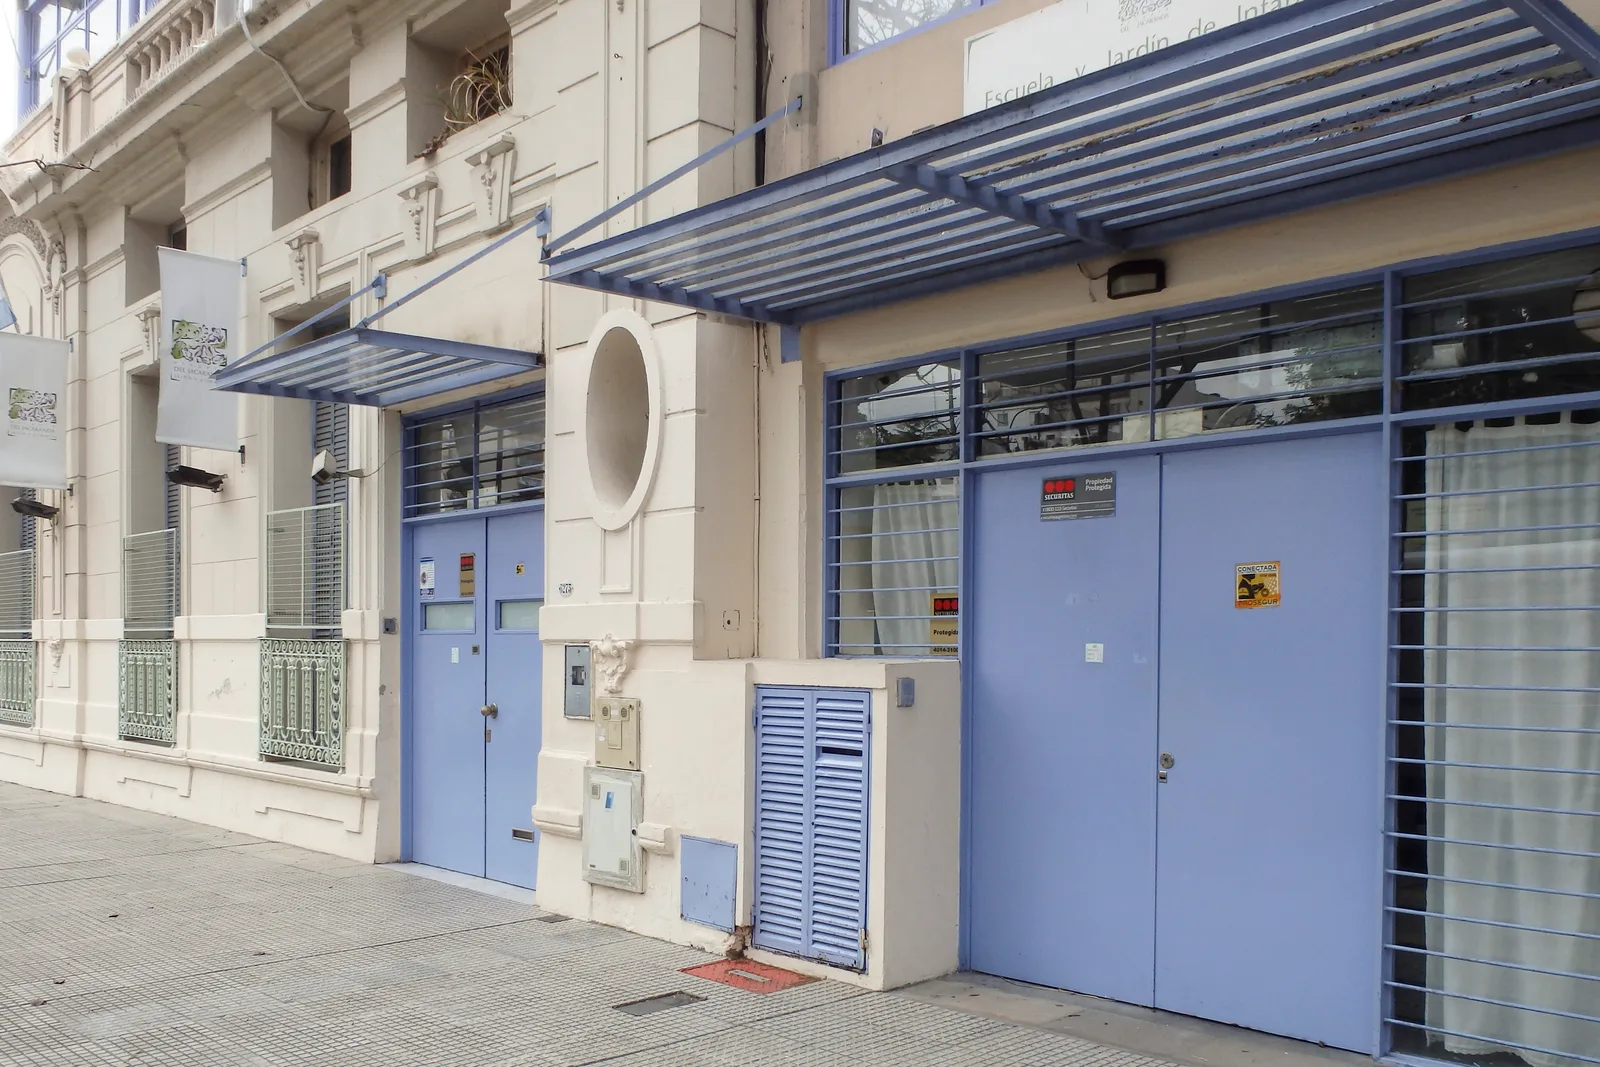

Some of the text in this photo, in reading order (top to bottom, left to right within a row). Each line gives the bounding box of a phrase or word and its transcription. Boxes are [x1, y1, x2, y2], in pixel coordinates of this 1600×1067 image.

[985, 72, 1054, 109] Escuela
[1108, 34, 1169, 67] Jardín
[1188, 18, 1216, 39] de
[1238, 0, 1299, 23] Infa
[1085, 477, 1112, 485] Propiedad
